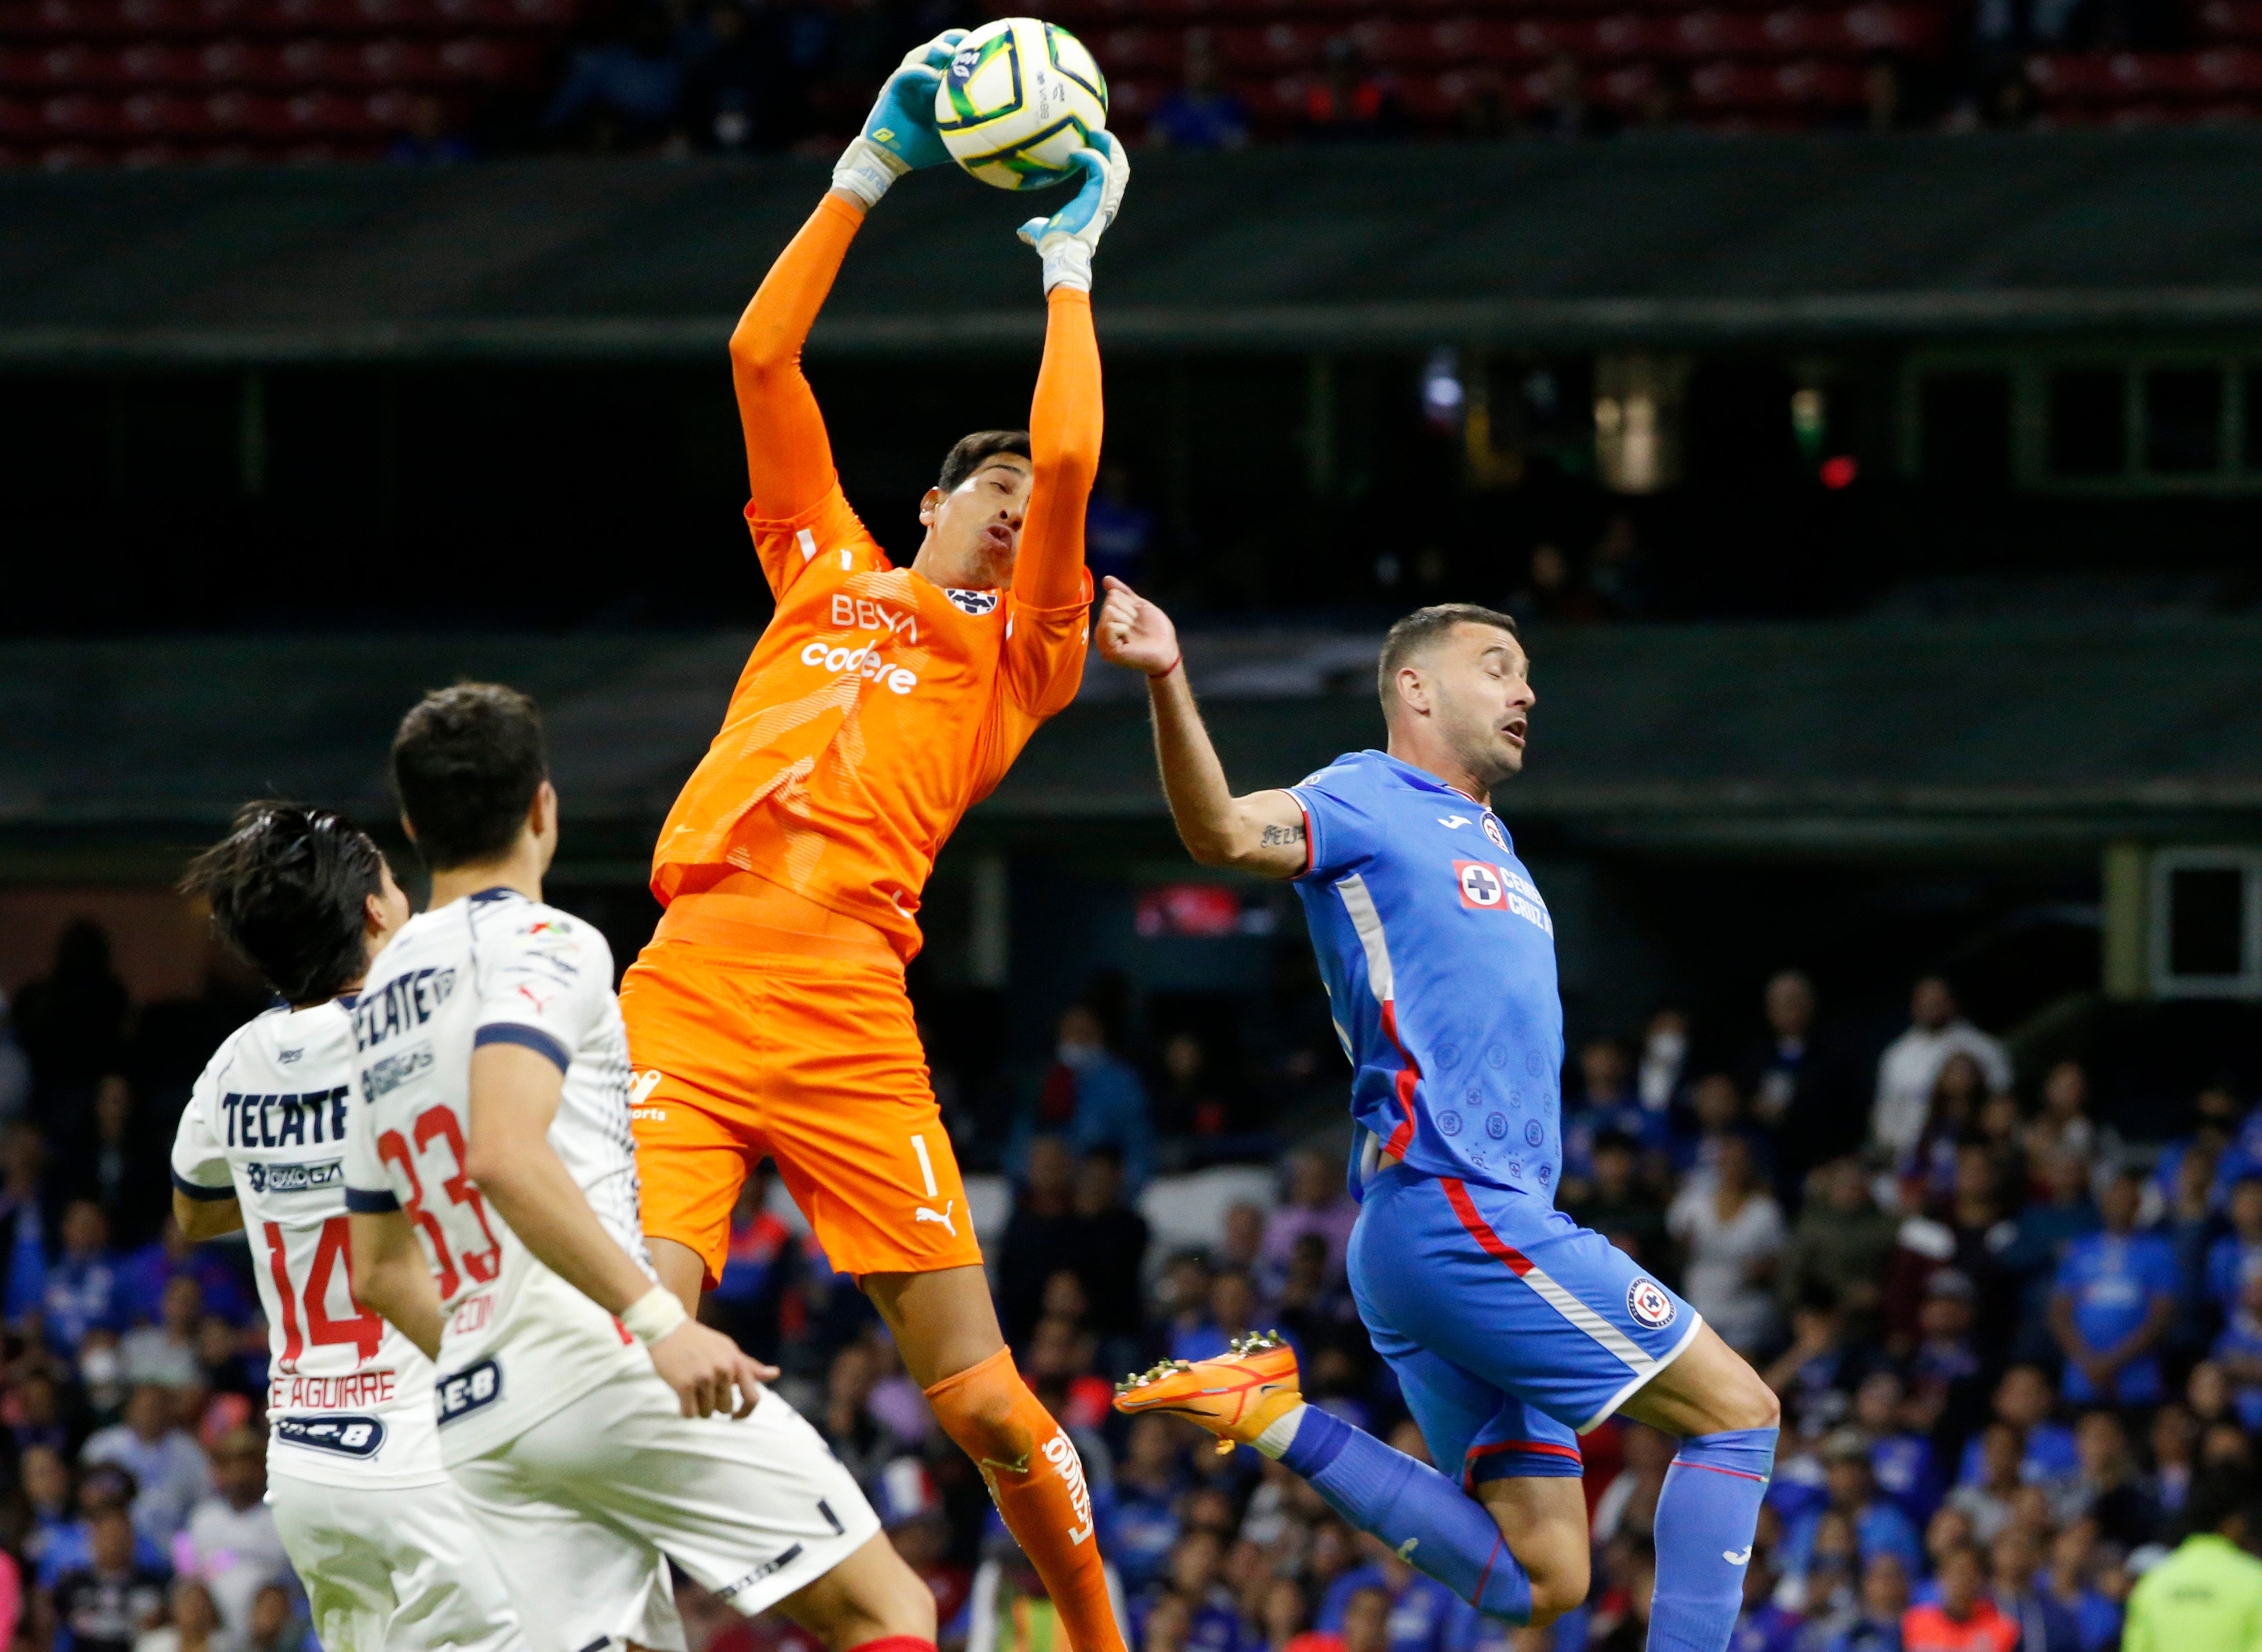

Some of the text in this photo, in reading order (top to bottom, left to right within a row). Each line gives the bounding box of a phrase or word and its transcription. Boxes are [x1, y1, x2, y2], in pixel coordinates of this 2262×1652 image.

[832, 594, 918, 644] BBVA
[801, 639, 917, 695] codere
[223, 1086, 348, 1148] TECATE
[910, 1134, 938, 1198] 1
[377, 1104, 501, 1300] 33
[263, 1217, 383, 1372] 14
[290, 1371, 395, 1409] AGUIRRE
